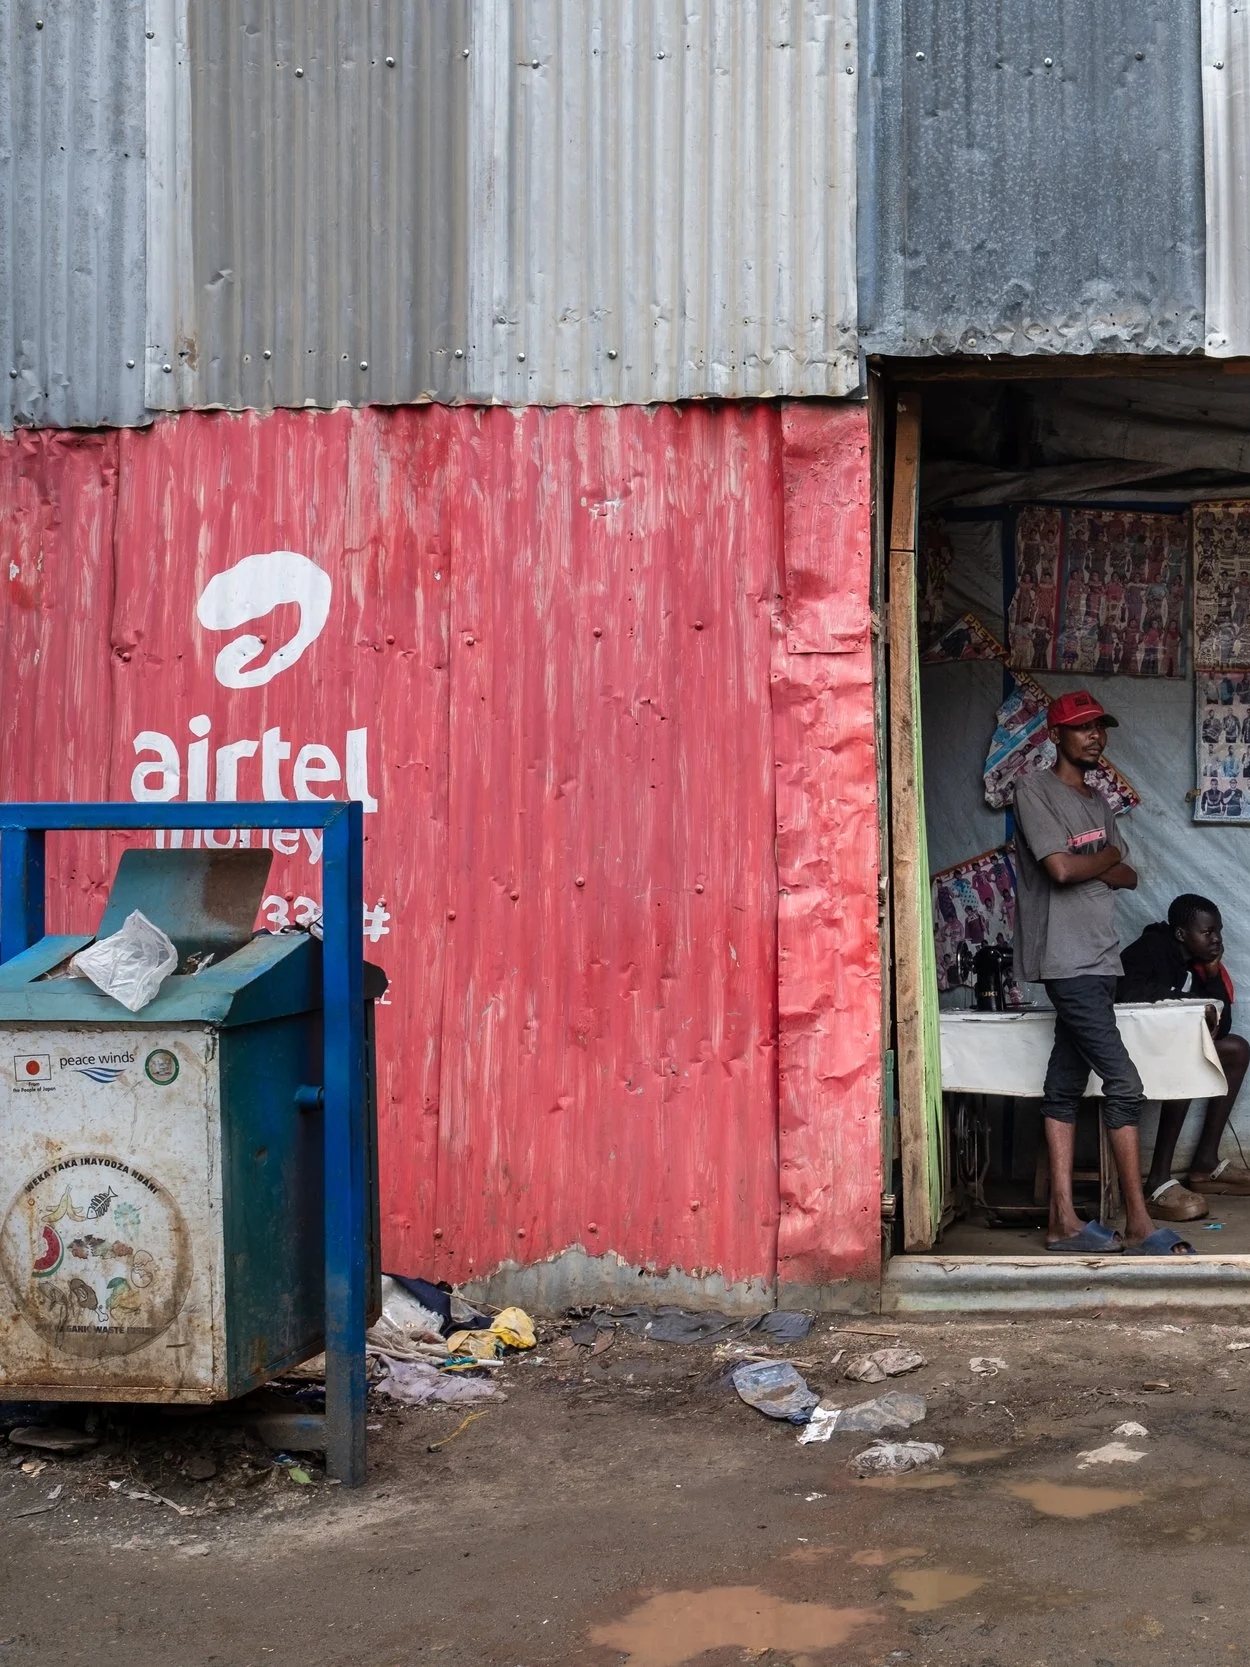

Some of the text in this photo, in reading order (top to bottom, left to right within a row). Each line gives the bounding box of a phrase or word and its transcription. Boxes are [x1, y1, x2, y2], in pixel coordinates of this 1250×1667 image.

[130, 714, 378, 813] airtel
[60, 1051, 135, 1068] peace winds
[25, 1172, 51, 1193] WEKA
[51, 1158, 78, 1174] TAKA
[130, 1169, 160, 1194] NDANI
[95, 1325, 125, 1334] WASTE
